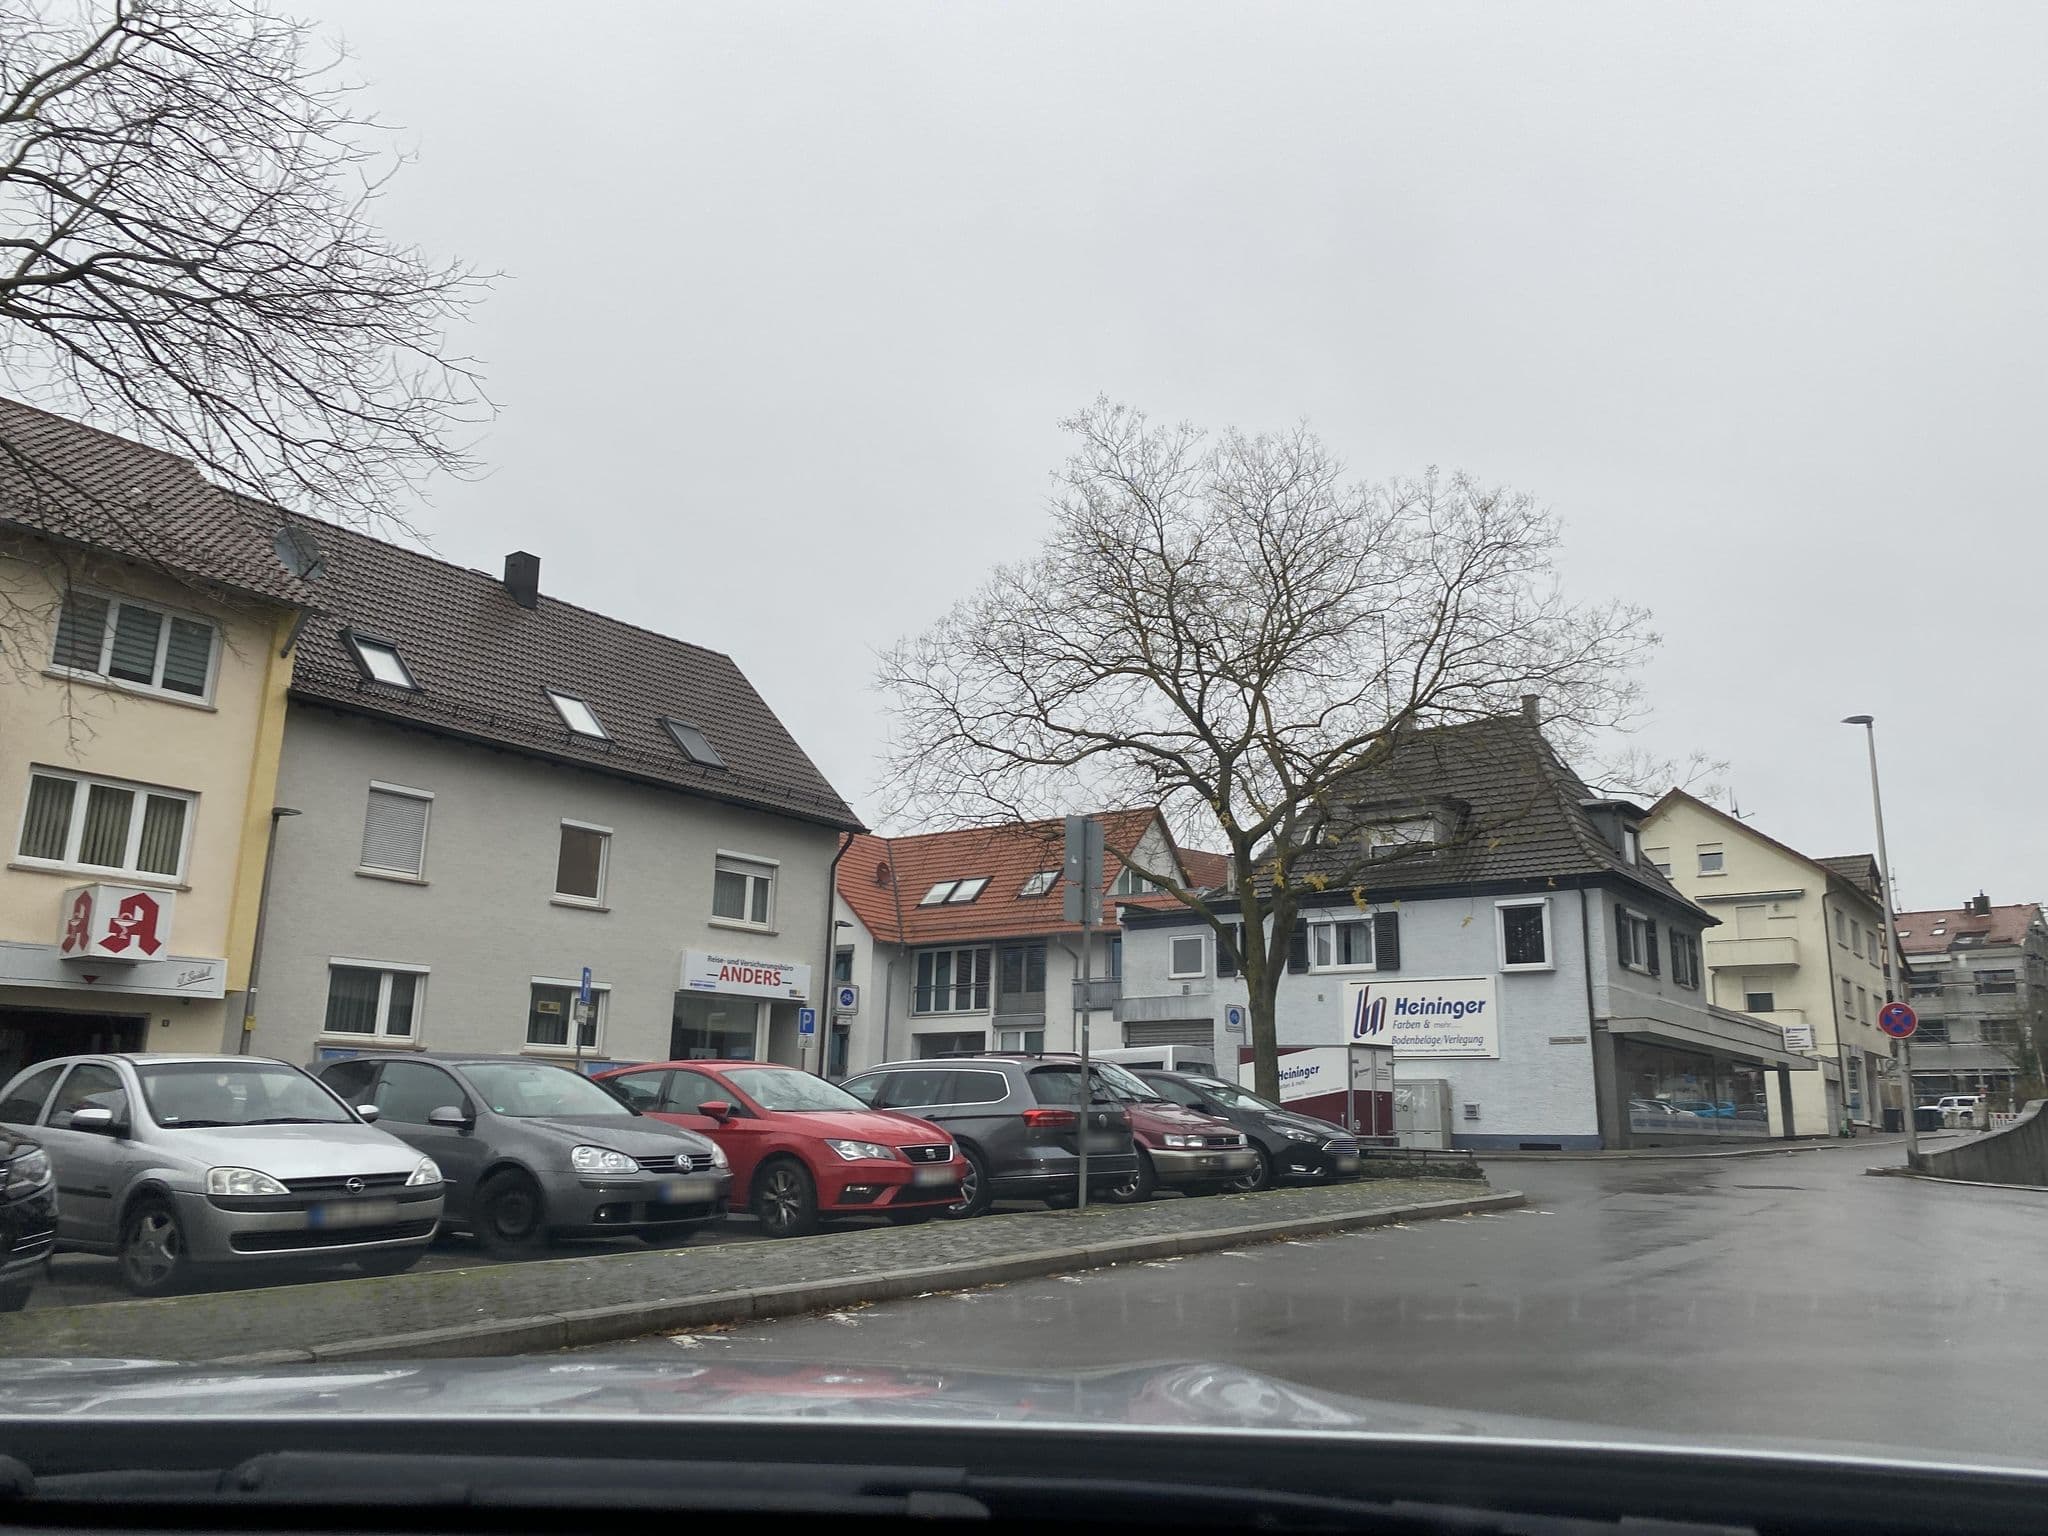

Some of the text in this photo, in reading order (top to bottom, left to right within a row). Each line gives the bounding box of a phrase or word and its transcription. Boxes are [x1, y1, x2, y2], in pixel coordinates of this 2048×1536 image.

[98, 892, 162, 956] A
[719, 965, 782, 987] ANDERS
[1394, 996, 1487, 1019] Heininger
[802, 1012, 813, 1031] P
[1392, 1019, 1421, 1030] Farben
[1423, 1019, 1431, 1029] &
[1278, 1065, 1321, 1081] Heininger
